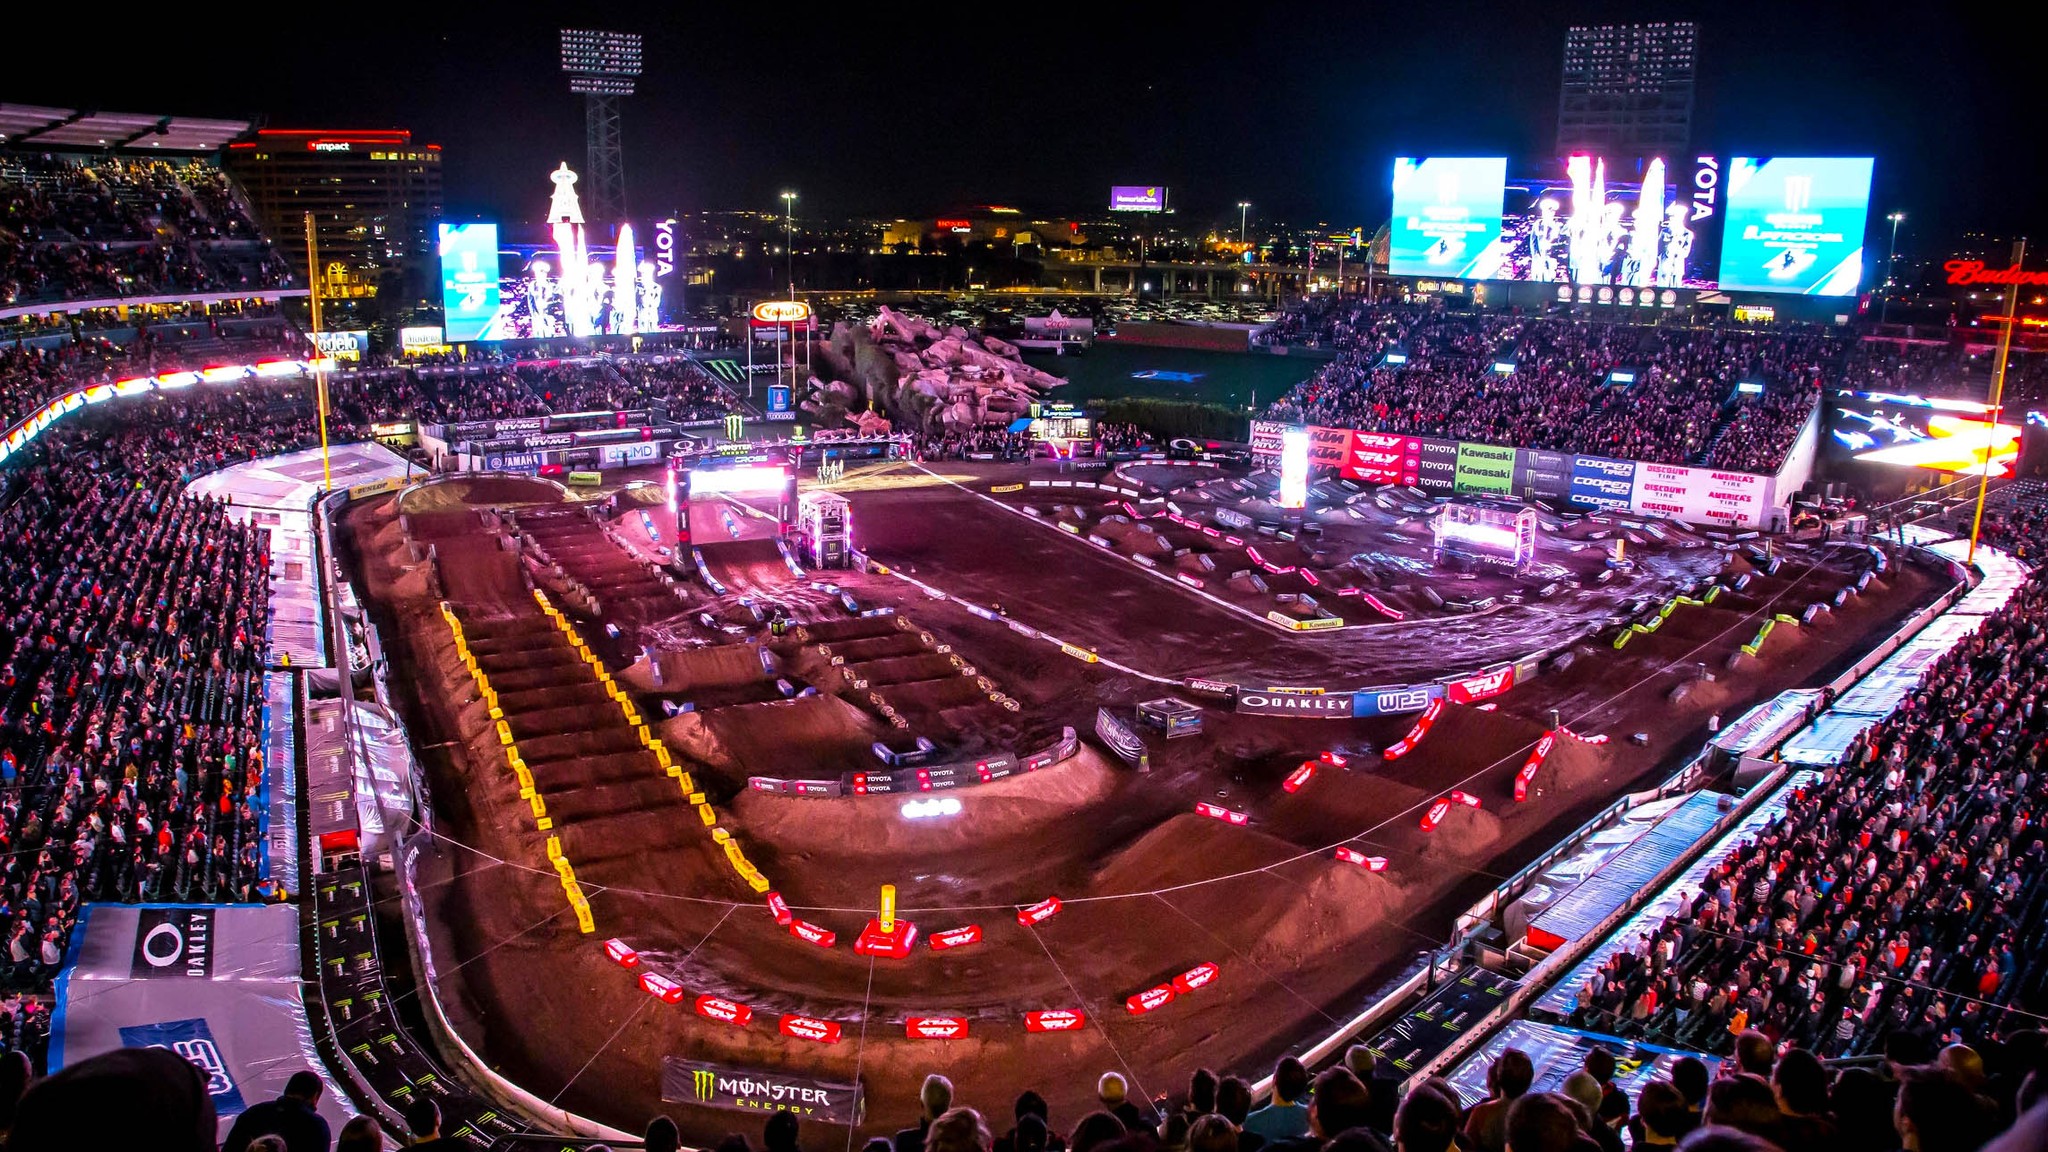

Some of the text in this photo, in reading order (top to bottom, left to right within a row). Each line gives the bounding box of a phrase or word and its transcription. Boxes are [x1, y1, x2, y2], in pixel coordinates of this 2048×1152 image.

[1691, 157, 1718, 221] YOTA
[1423, 443, 1456, 454] TOYOTA
[1461, 447, 1512, 461] Kawasaki
[1421, 461, 1454, 471] TOYOTA
[1459, 464, 1510, 479] Kawasaki
[1576, 458, 1634, 472] COOPER
[1647, 465, 1689, 476] DISCOUNT
[1420, 478, 1453, 488] TOYOTA
[1573, 476, 1631, 490] COOPER
[1711, 472, 1755, 483] AMERICA'S
[357, 482, 388, 494] DUNLOP
[1457, 482, 1509, 495] Kawasaki
[1644, 483, 1686, 495] DISCOUNT
[1571, 494, 1629, 508] COOPER
[1708, 491, 1752, 502] AMERICA'S
[1641, 502, 1684, 513] DISCOUNT
[1065, 646, 1089, 660] SUZUKI
[1271, 697, 1348, 710] OAKLEY
[1377, 690, 1429, 713] WPS
[929, 769, 954, 777] TOYOTA
[932, 780, 955, 788] TOYOTA
[186, 912, 208, 977] OAKLEY
[718, 1077, 831, 1107] MONSTER
[736, 1098, 814, 1116] ENERGY
